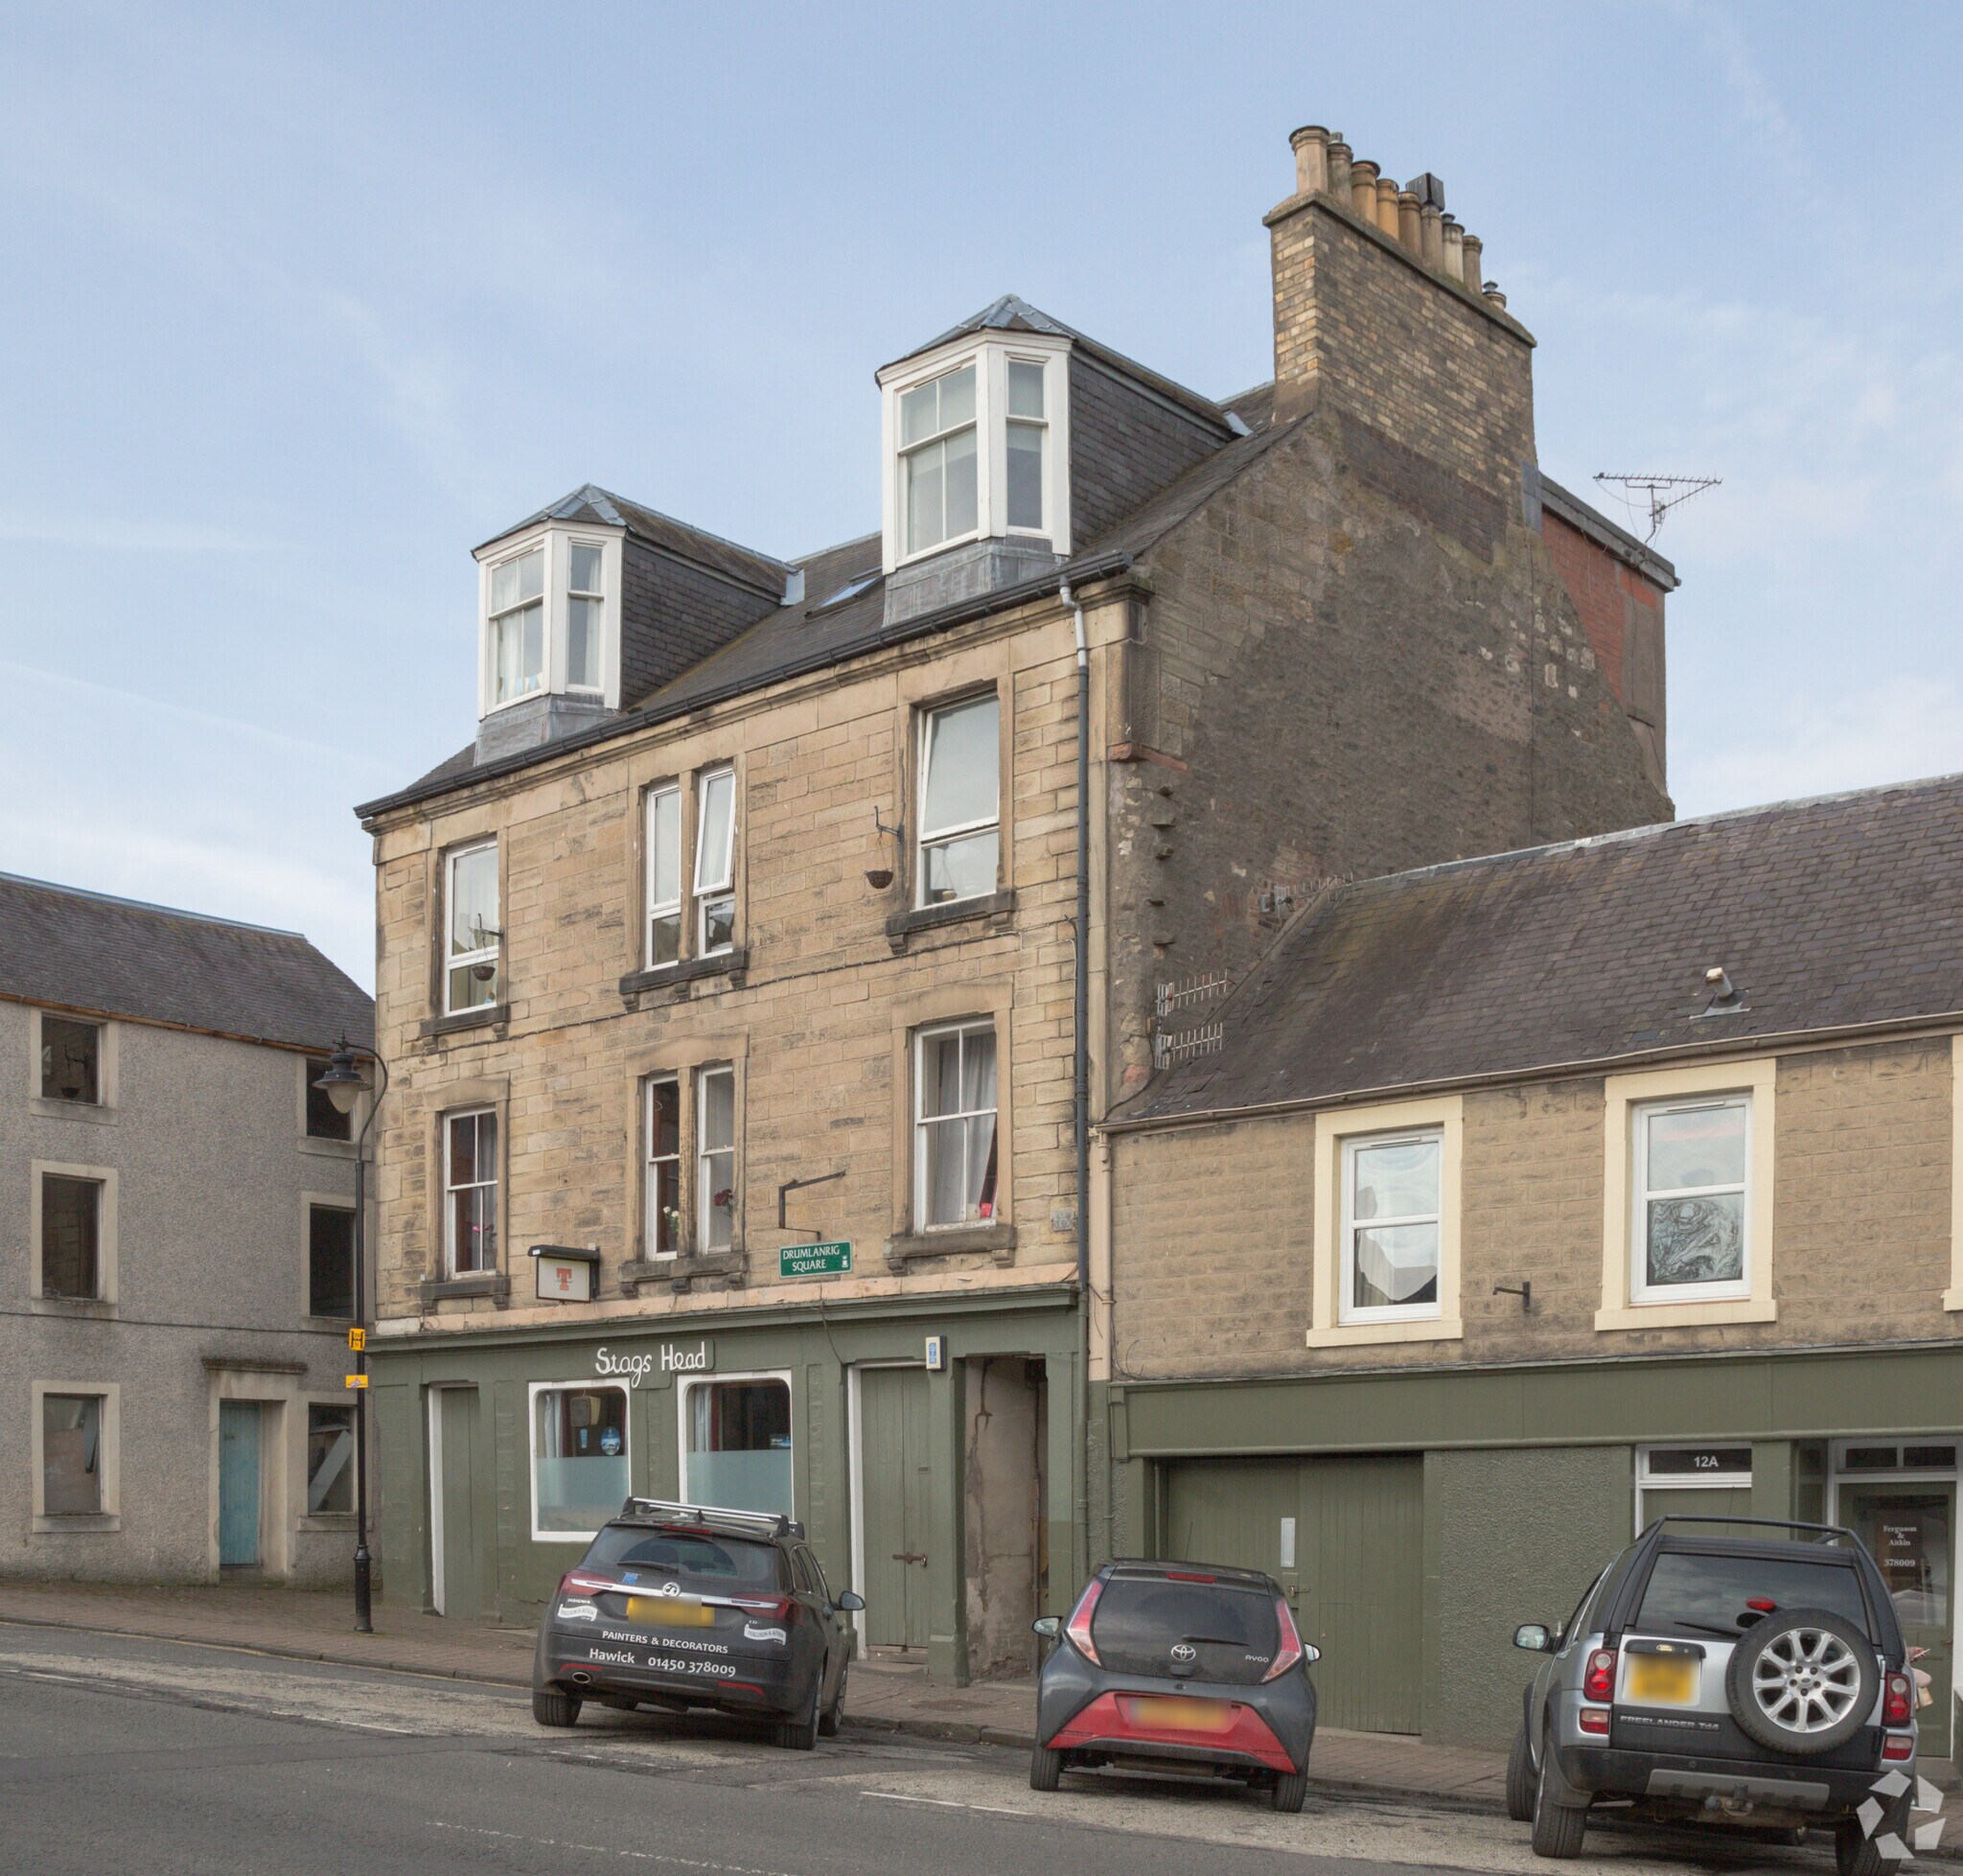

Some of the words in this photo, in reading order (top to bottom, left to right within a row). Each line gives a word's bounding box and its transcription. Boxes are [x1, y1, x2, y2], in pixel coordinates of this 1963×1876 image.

[782, 1245, 841, 1260] DRUMLANRIG
[792, 1259, 827, 1272] SQUARE
[556, 1267, 572, 1291] T
[595, 1347, 653, 1388] Stags
[660, 1341, 706, 1371] Head
[1694, 1455, 1719, 1468] 12A
[1882, 1525, 1917, 1535] Ferguson
[1883, 1559, 1916, 1567] 378009
[602, 1631, 648, 1644] PAINTERS
[651, 1636, 659, 1646] &
[662, 1637, 728, 1655] DECORATORS
[589, 1648, 635, 1664] Hawick
[648, 1656, 685, 1671] 01450
[688, 1661, 736, 1678] 378009
[1245, 1655, 1269, 1663] AYGO
[1620, 1715, 1695, 1727] FREELANDER
